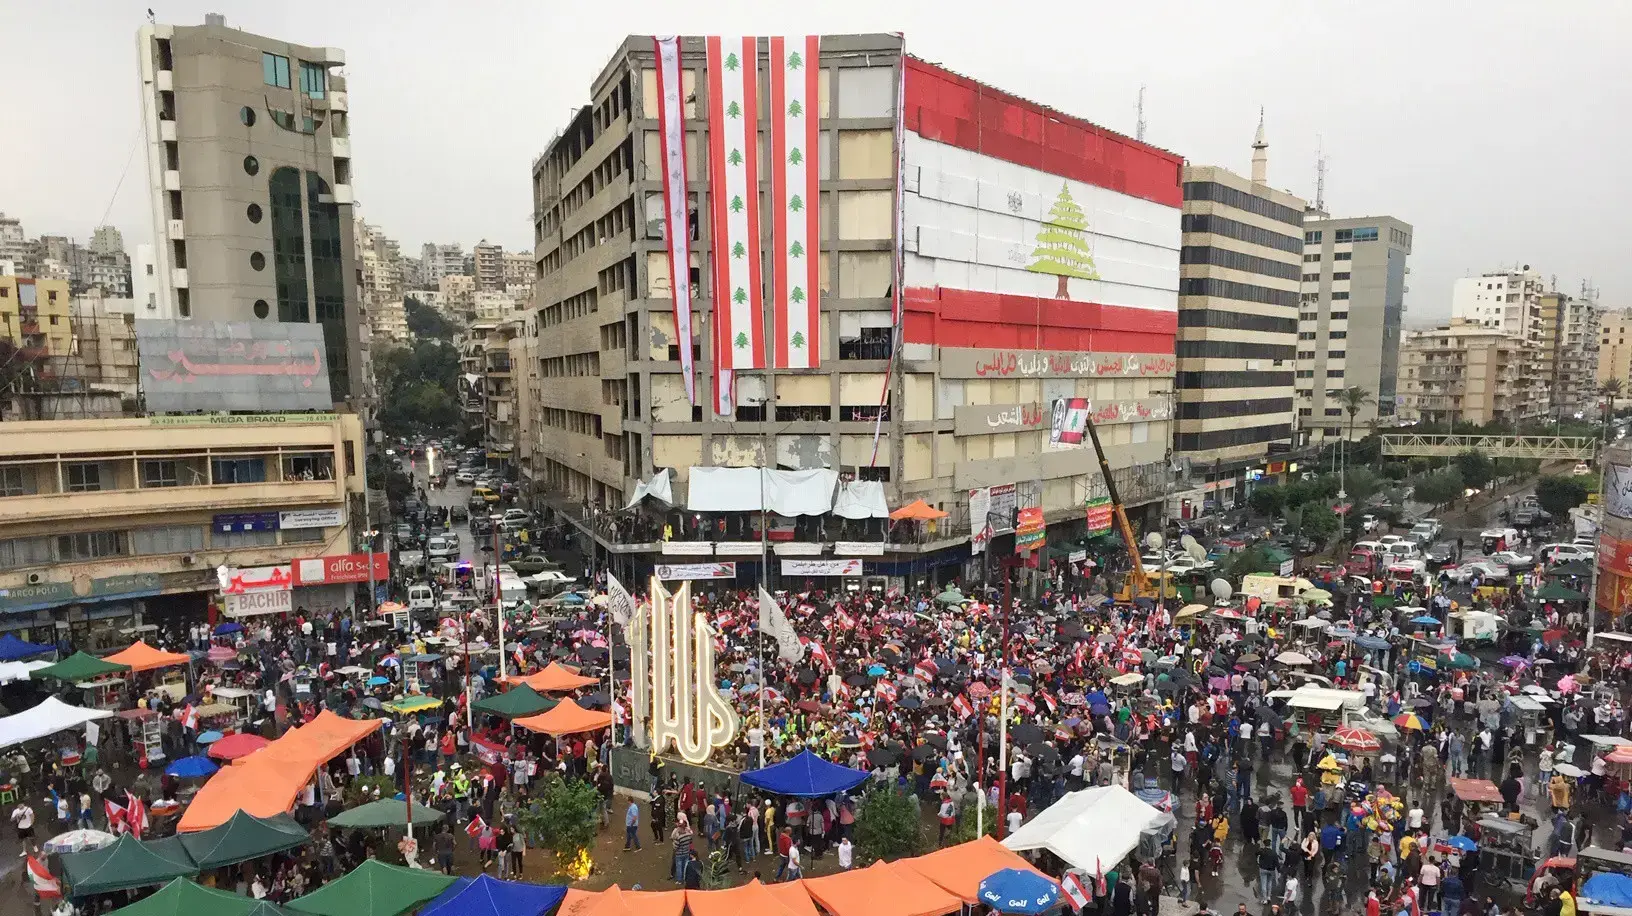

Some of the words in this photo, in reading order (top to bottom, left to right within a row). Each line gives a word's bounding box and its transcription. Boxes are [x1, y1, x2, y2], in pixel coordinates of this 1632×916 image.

[975, 352, 1017, 376] طرابلس
[210, 416, 244, 424] MEGA
[987, 405, 1022, 431] الشعب
[330, 559, 354, 572] alfa
[355, 560, 381, 571] Stoe
[222, 567, 292, 595] بشير
[239, 591, 289, 610] BACHIR
[984, 890, 1002, 902] Golf
[1036, 893, 1051, 906] Golf
[1008, 899, 1028, 908] Golf
